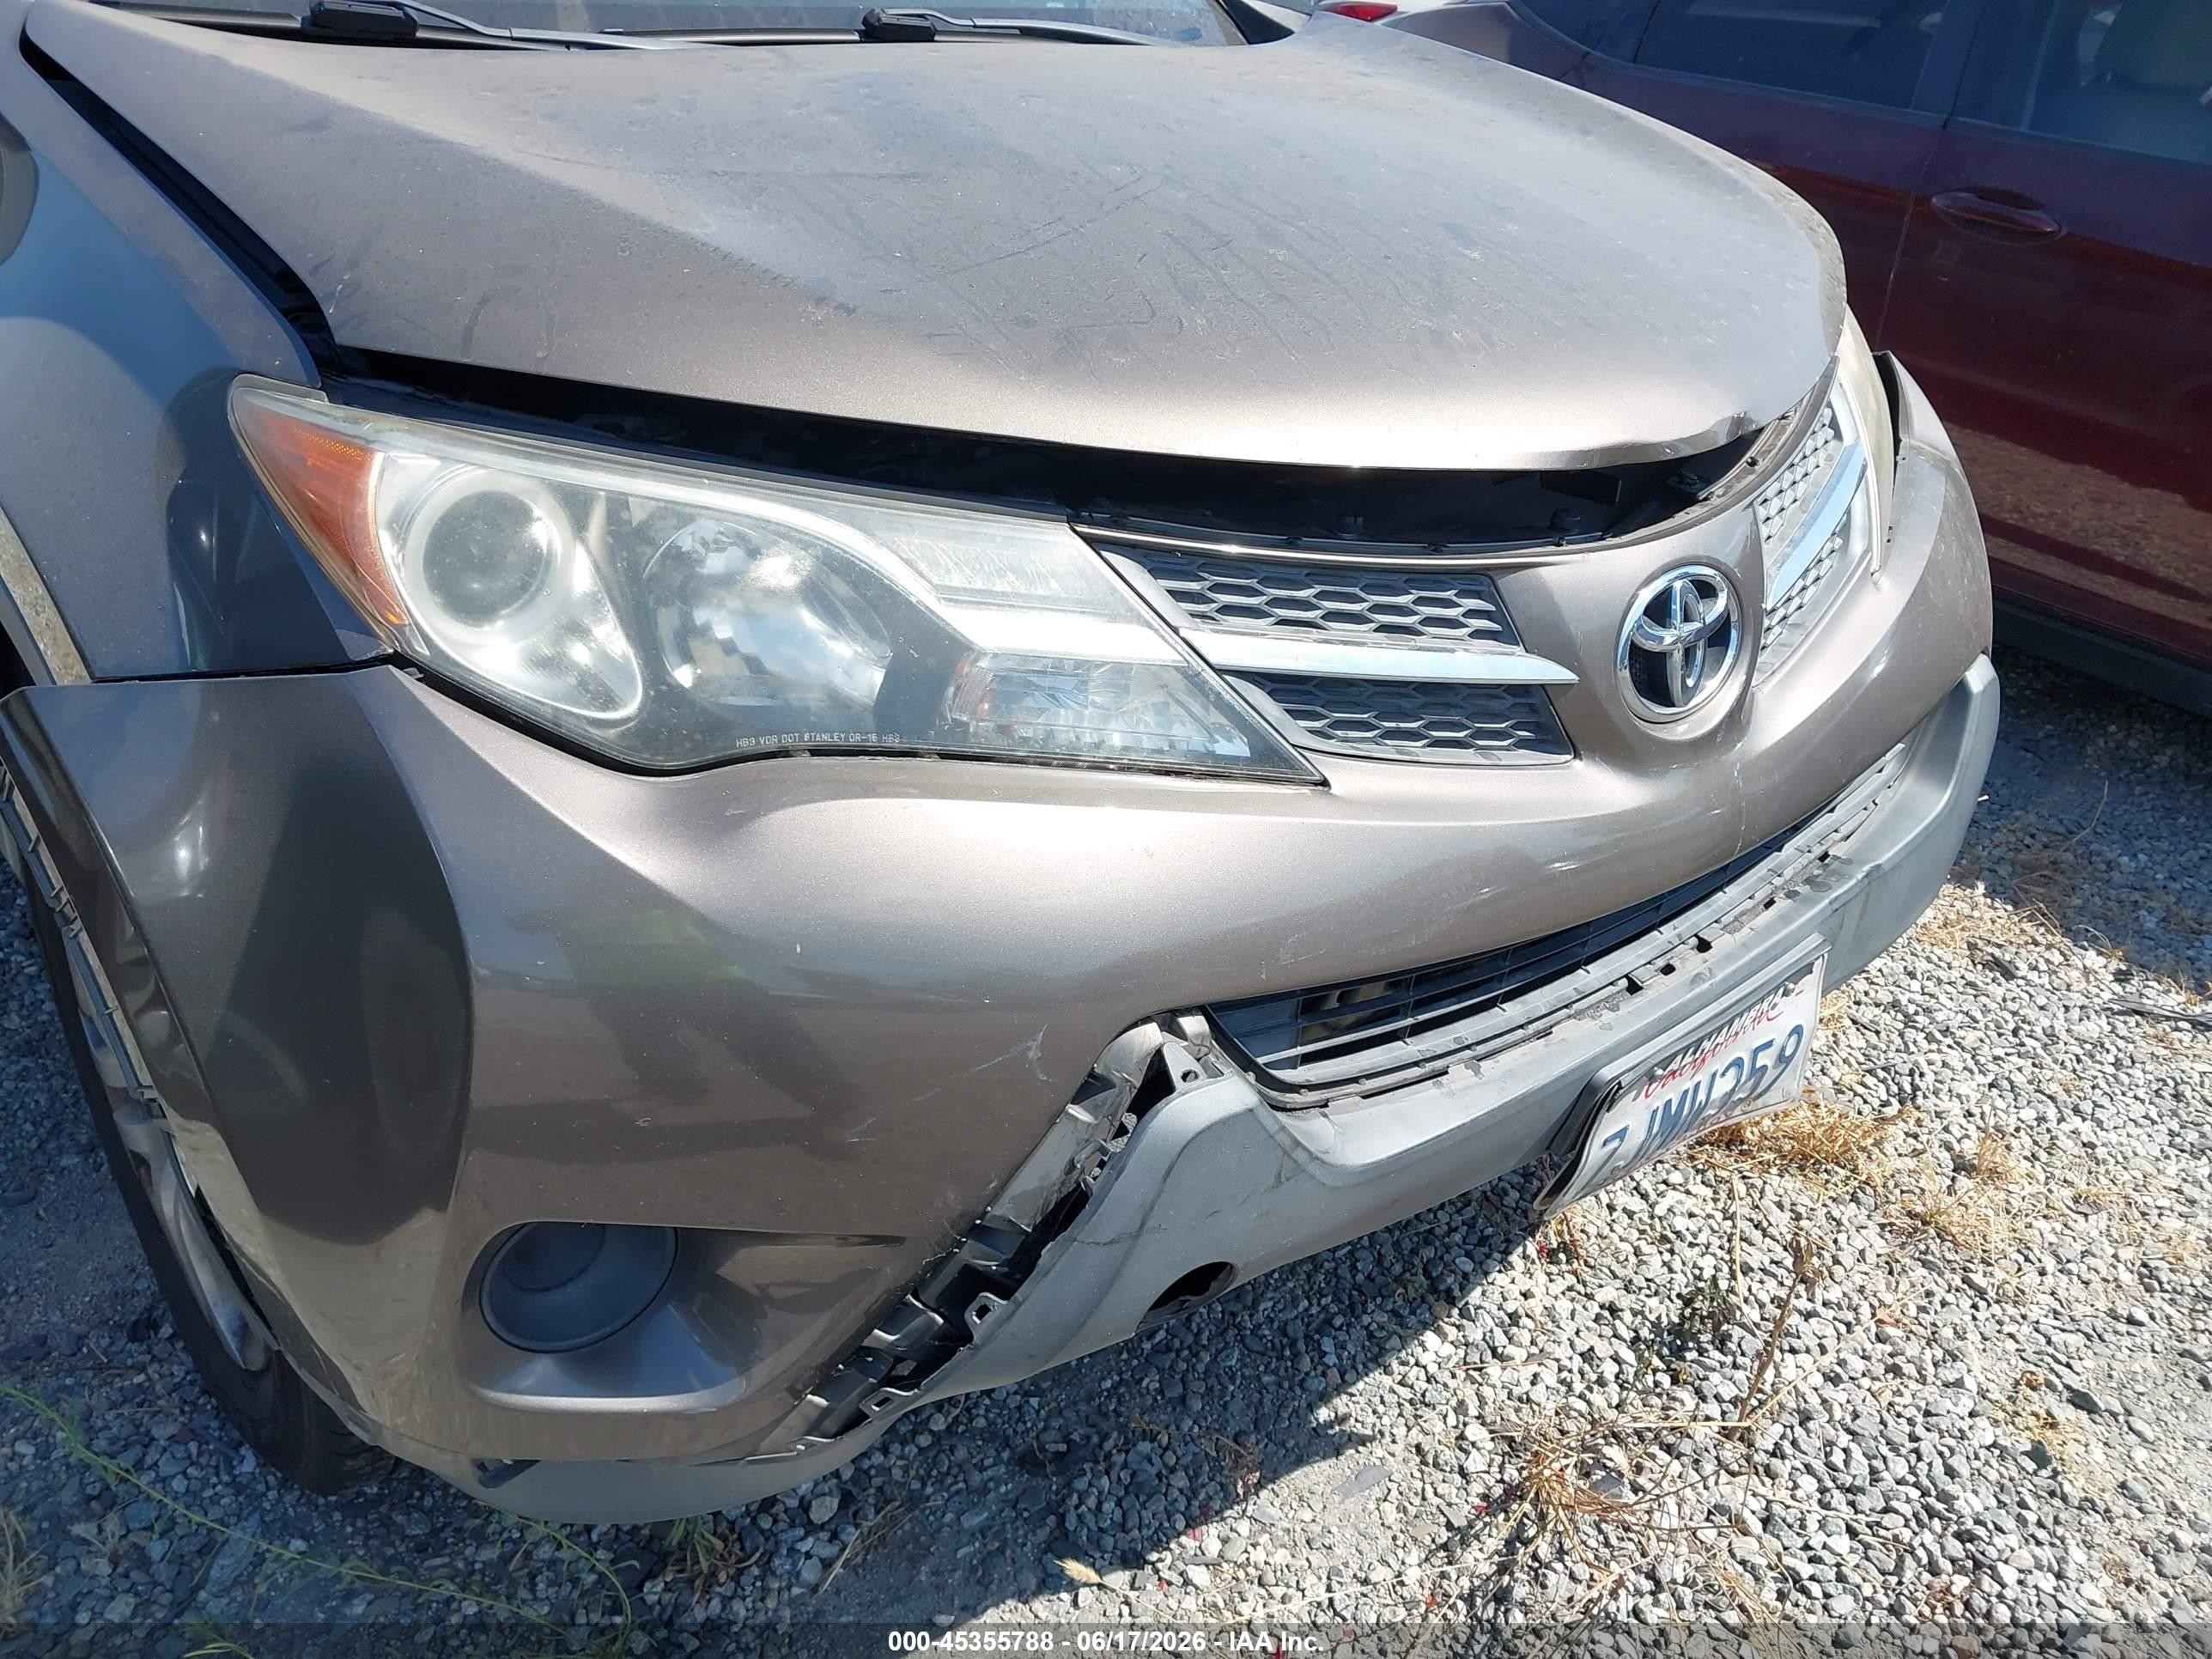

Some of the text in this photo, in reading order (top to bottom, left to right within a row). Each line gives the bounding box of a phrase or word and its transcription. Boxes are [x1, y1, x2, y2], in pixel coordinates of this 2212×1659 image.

[781, 732, 799, 743] DOT
[804, 732, 845, 742] STANLEY
[1664, 985, 1785, 1074] ALHAMBRA
